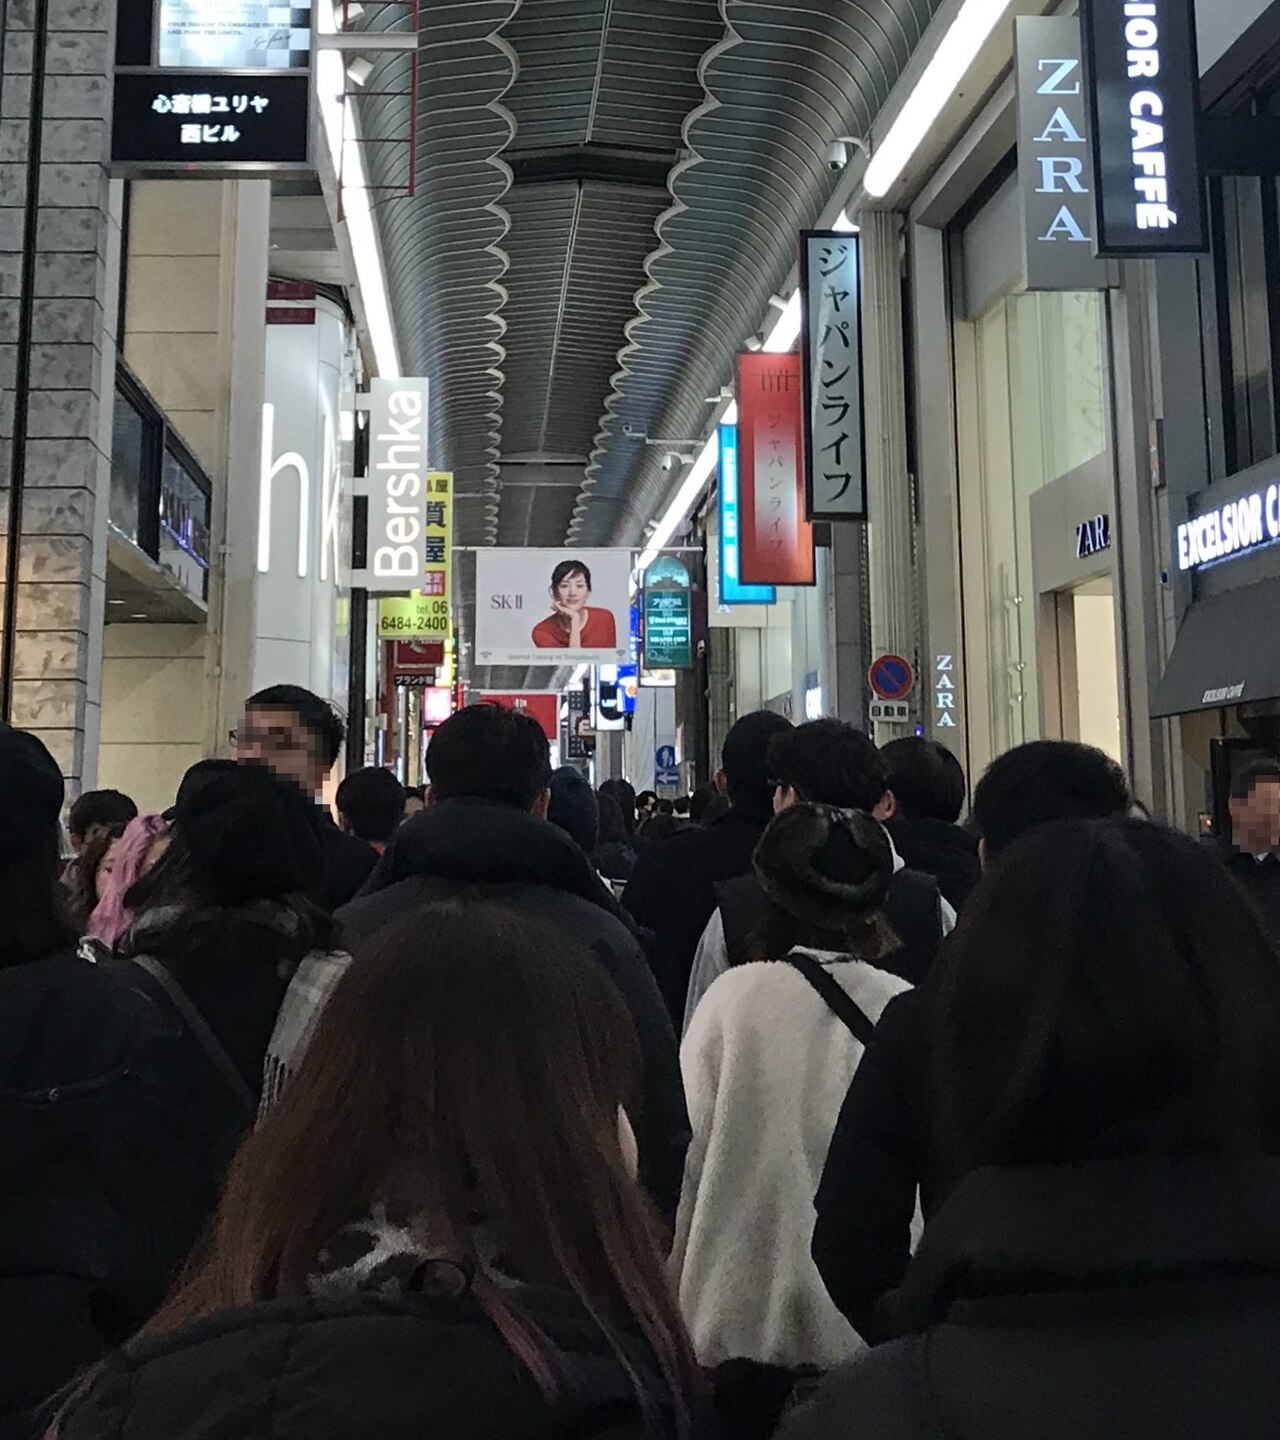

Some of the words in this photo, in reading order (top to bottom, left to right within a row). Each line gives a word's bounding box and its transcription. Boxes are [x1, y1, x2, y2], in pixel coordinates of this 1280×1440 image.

[1033, 58, 1092, 243] ZARA
[1129, 89, 1177, 230] CAFFÉ
[818, 246, 853, 502] ジャパンライフ
[373, 389, 421, 577] Bershka
[1075, 515, 1111, 560] ZAR
[1177, 494, 1264, 571] EXCELSIOR
[380, 615, 448, 631] 6484-2400
[432, 600, 448, 615] 06
[935, 654, 957, 727] ZARA
